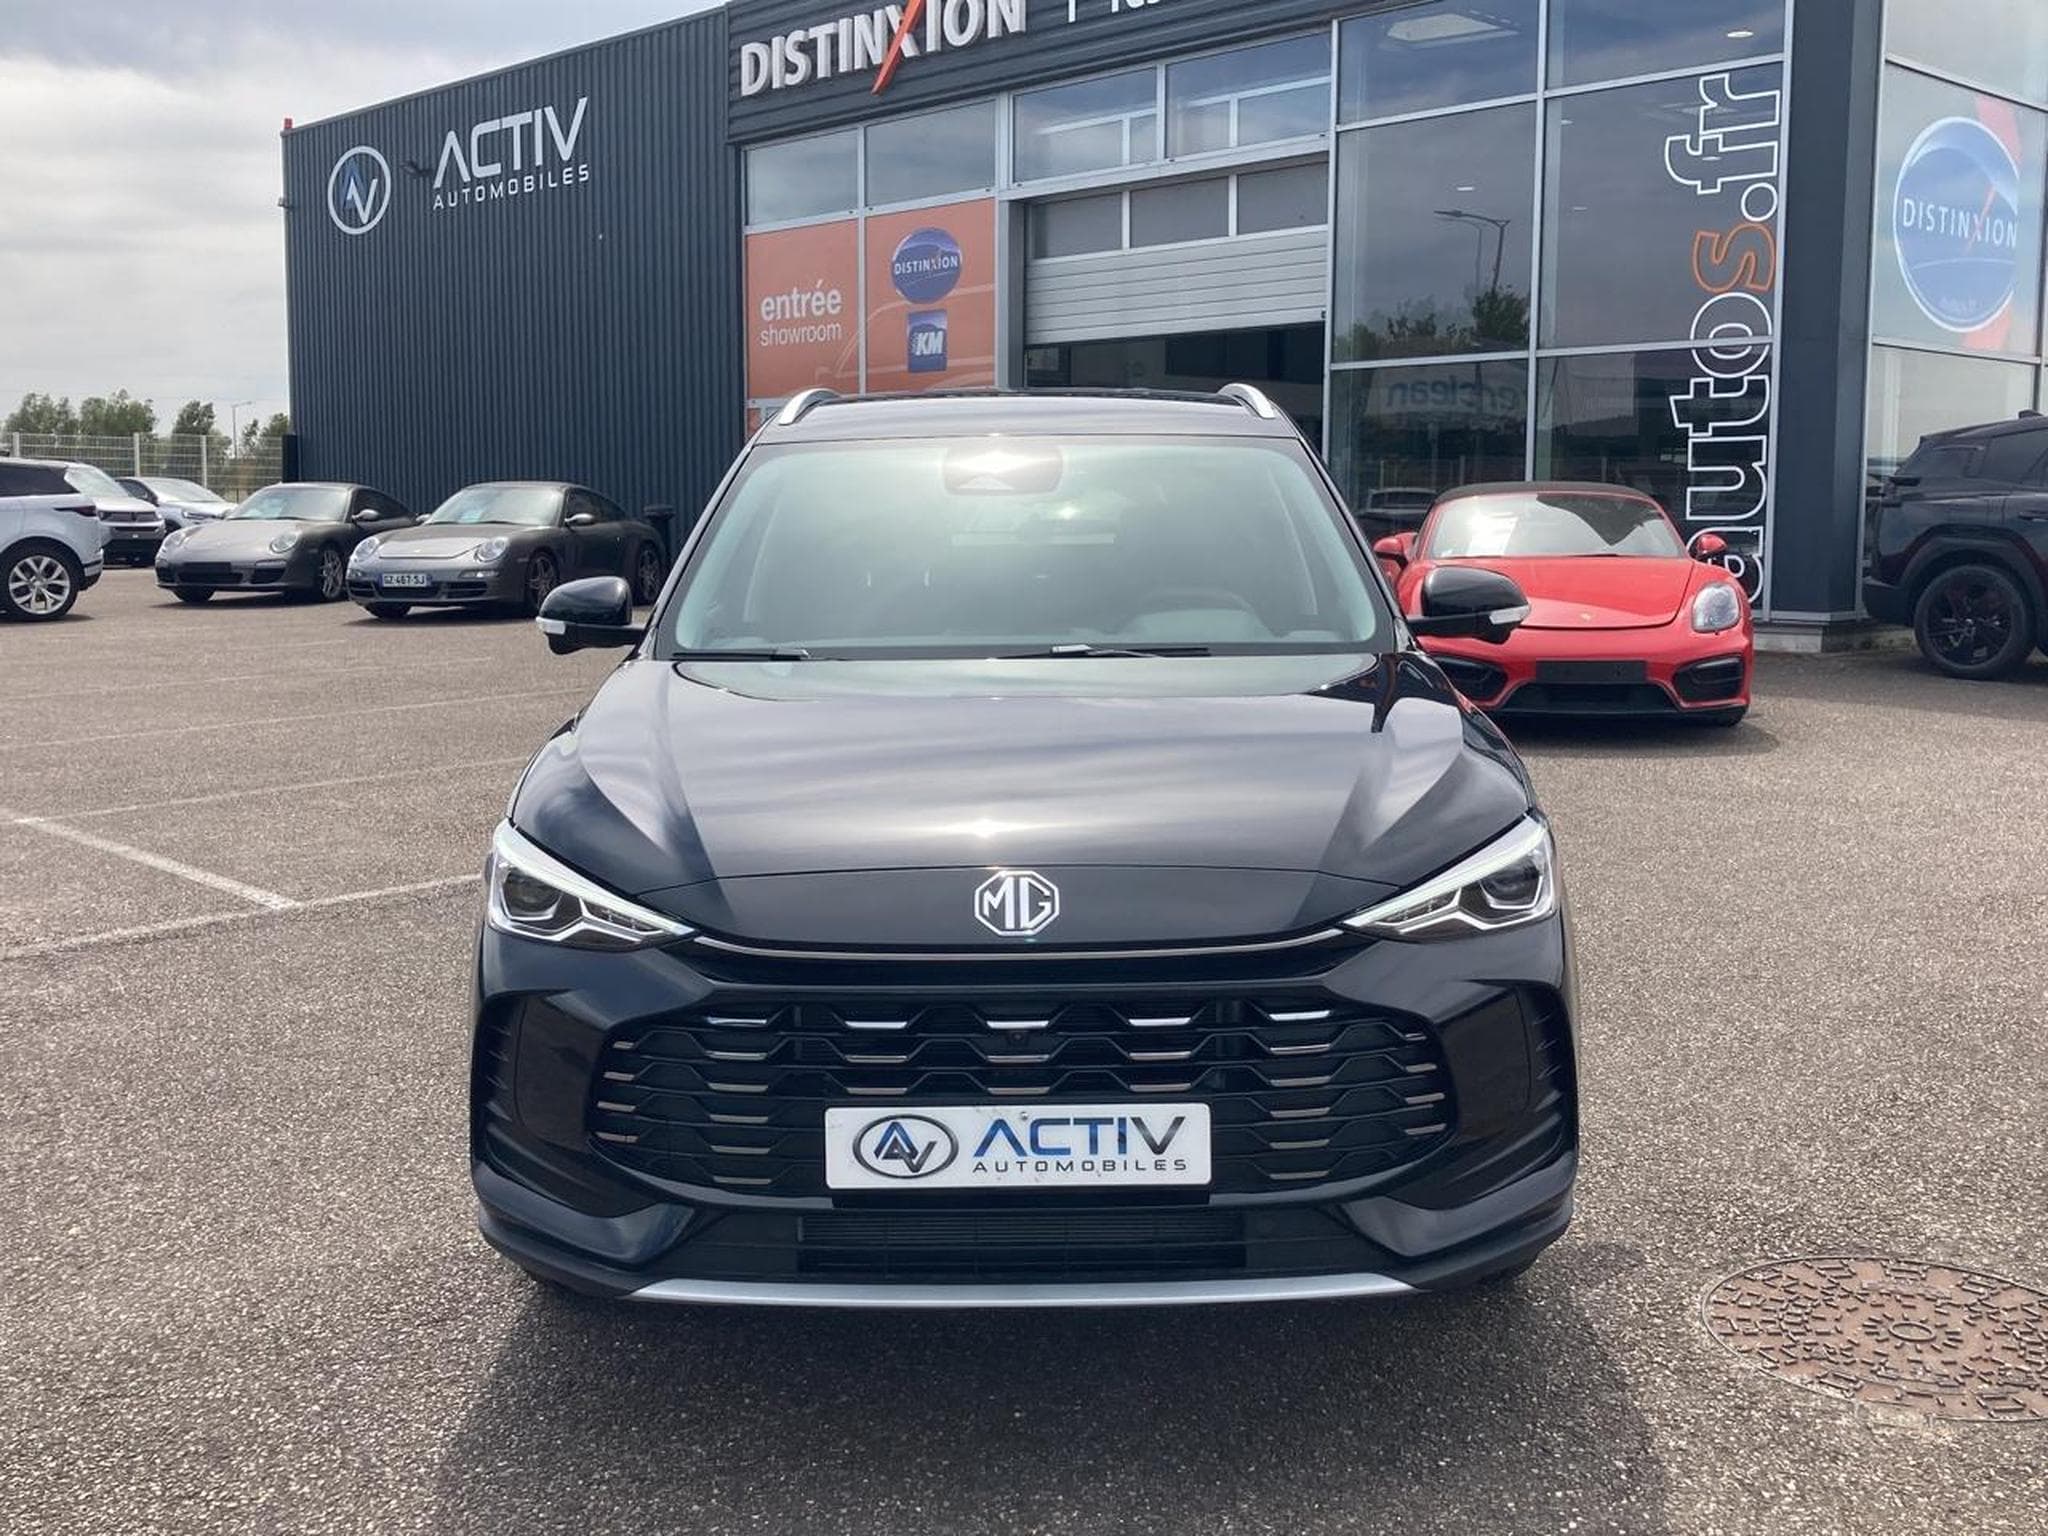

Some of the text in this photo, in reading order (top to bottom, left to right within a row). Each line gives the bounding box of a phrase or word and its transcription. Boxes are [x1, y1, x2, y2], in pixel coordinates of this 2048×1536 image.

[741, 0, 1026, 97] DISTINXION
[433, 96, 588, 189] ACTIV
[433, 164, 589, 211] AUTOMOBILES
[1903, 192, 2018, 250] DISTINXION
[894, 252, 959, 276] DISTINXION
[760, 279, 842, 321] entrée
[760, 322, 842, 347] showroom
[982, 875, 1052, 930] MG
[973, 1116, 1187, 1158] ACTIV
[972, 1159, 1188, 1173] AUTOMOBILES
